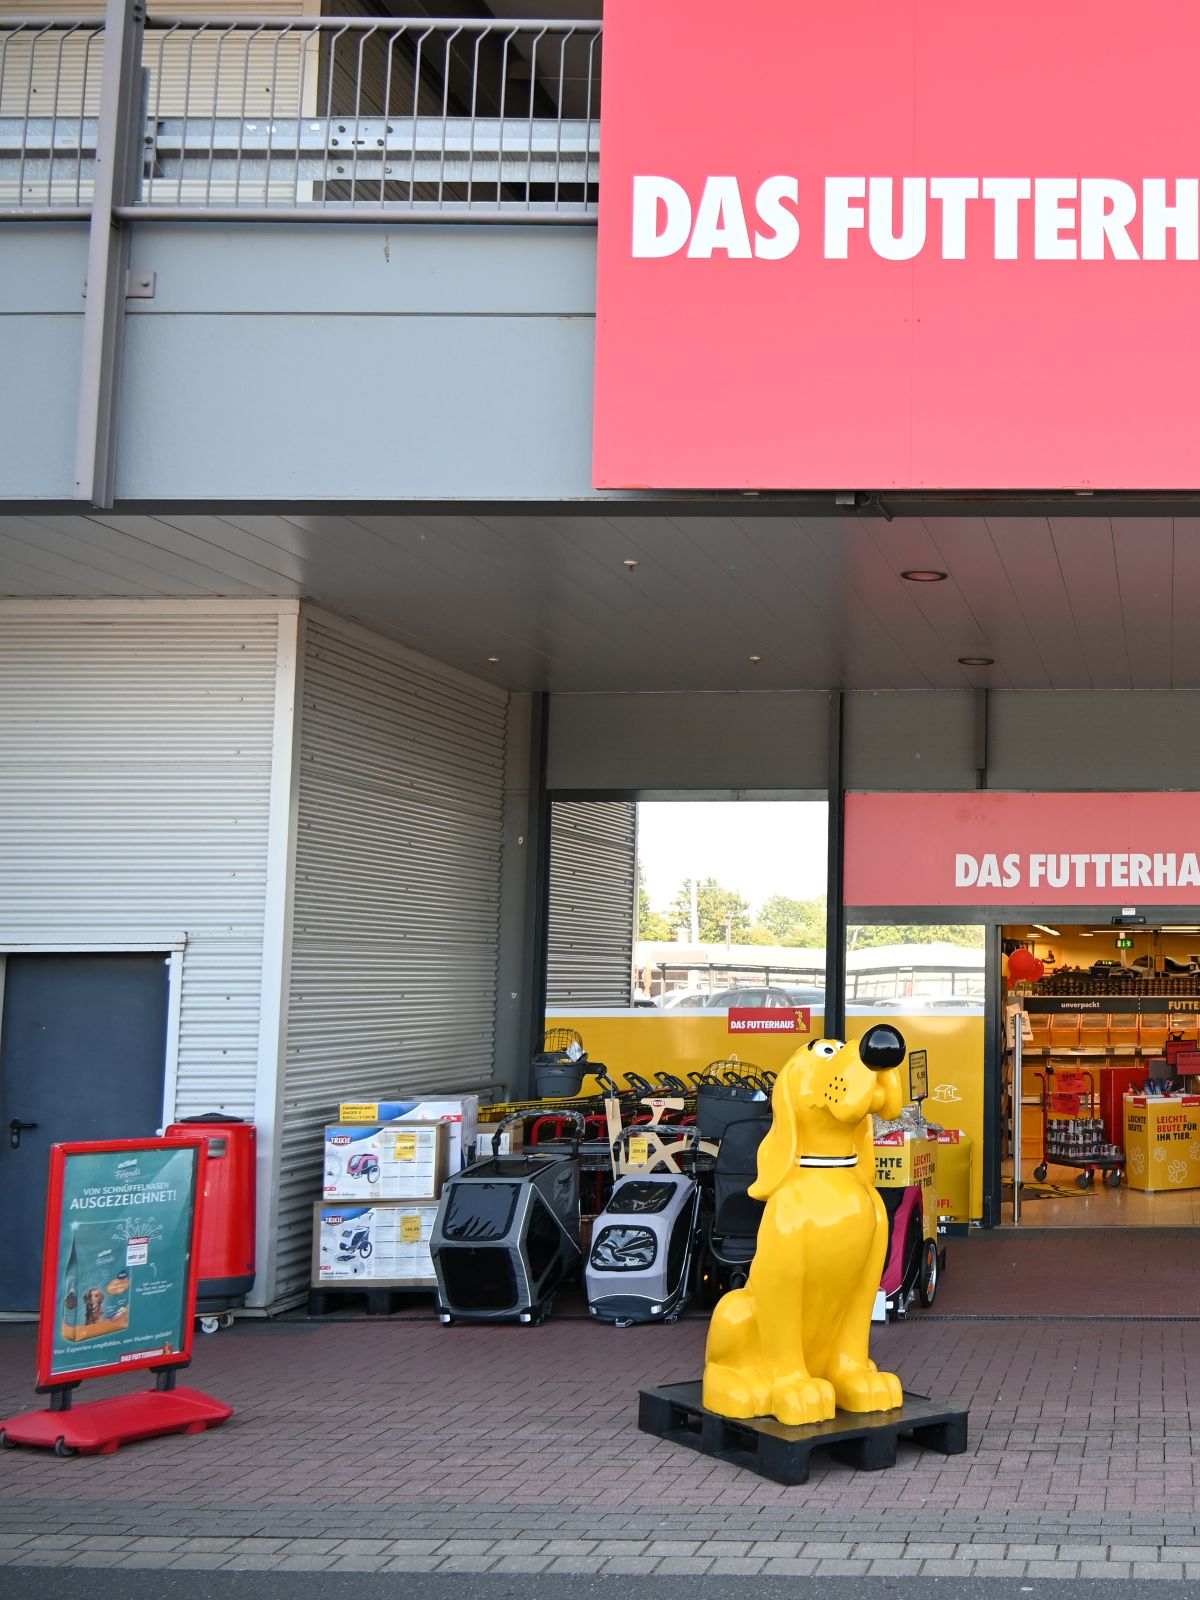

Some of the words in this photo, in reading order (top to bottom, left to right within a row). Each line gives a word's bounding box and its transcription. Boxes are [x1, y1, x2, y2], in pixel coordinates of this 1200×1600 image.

[632, 175, 800, 260] DAS
[955, 853, 1021, 888] DAS
[1061, 1001, 1100, 1009] unverpackt
[730, 1020, 746, 1029] DAS
[746, 1020, 795, 1029] FUTTERHAUS
[1157, 1115, 1187, 1124] LEICHTE
[1182, 1122, 1197, 1131] FÜR
[1157, 1133, 1171, 1141] IHR
[83, 1187, 101, 1196] VON
[103, 1182, 170, 1194] SCHNÜFFELNASEN
[69, 1189, 177, 1210] AUSGEZEICHNET!
